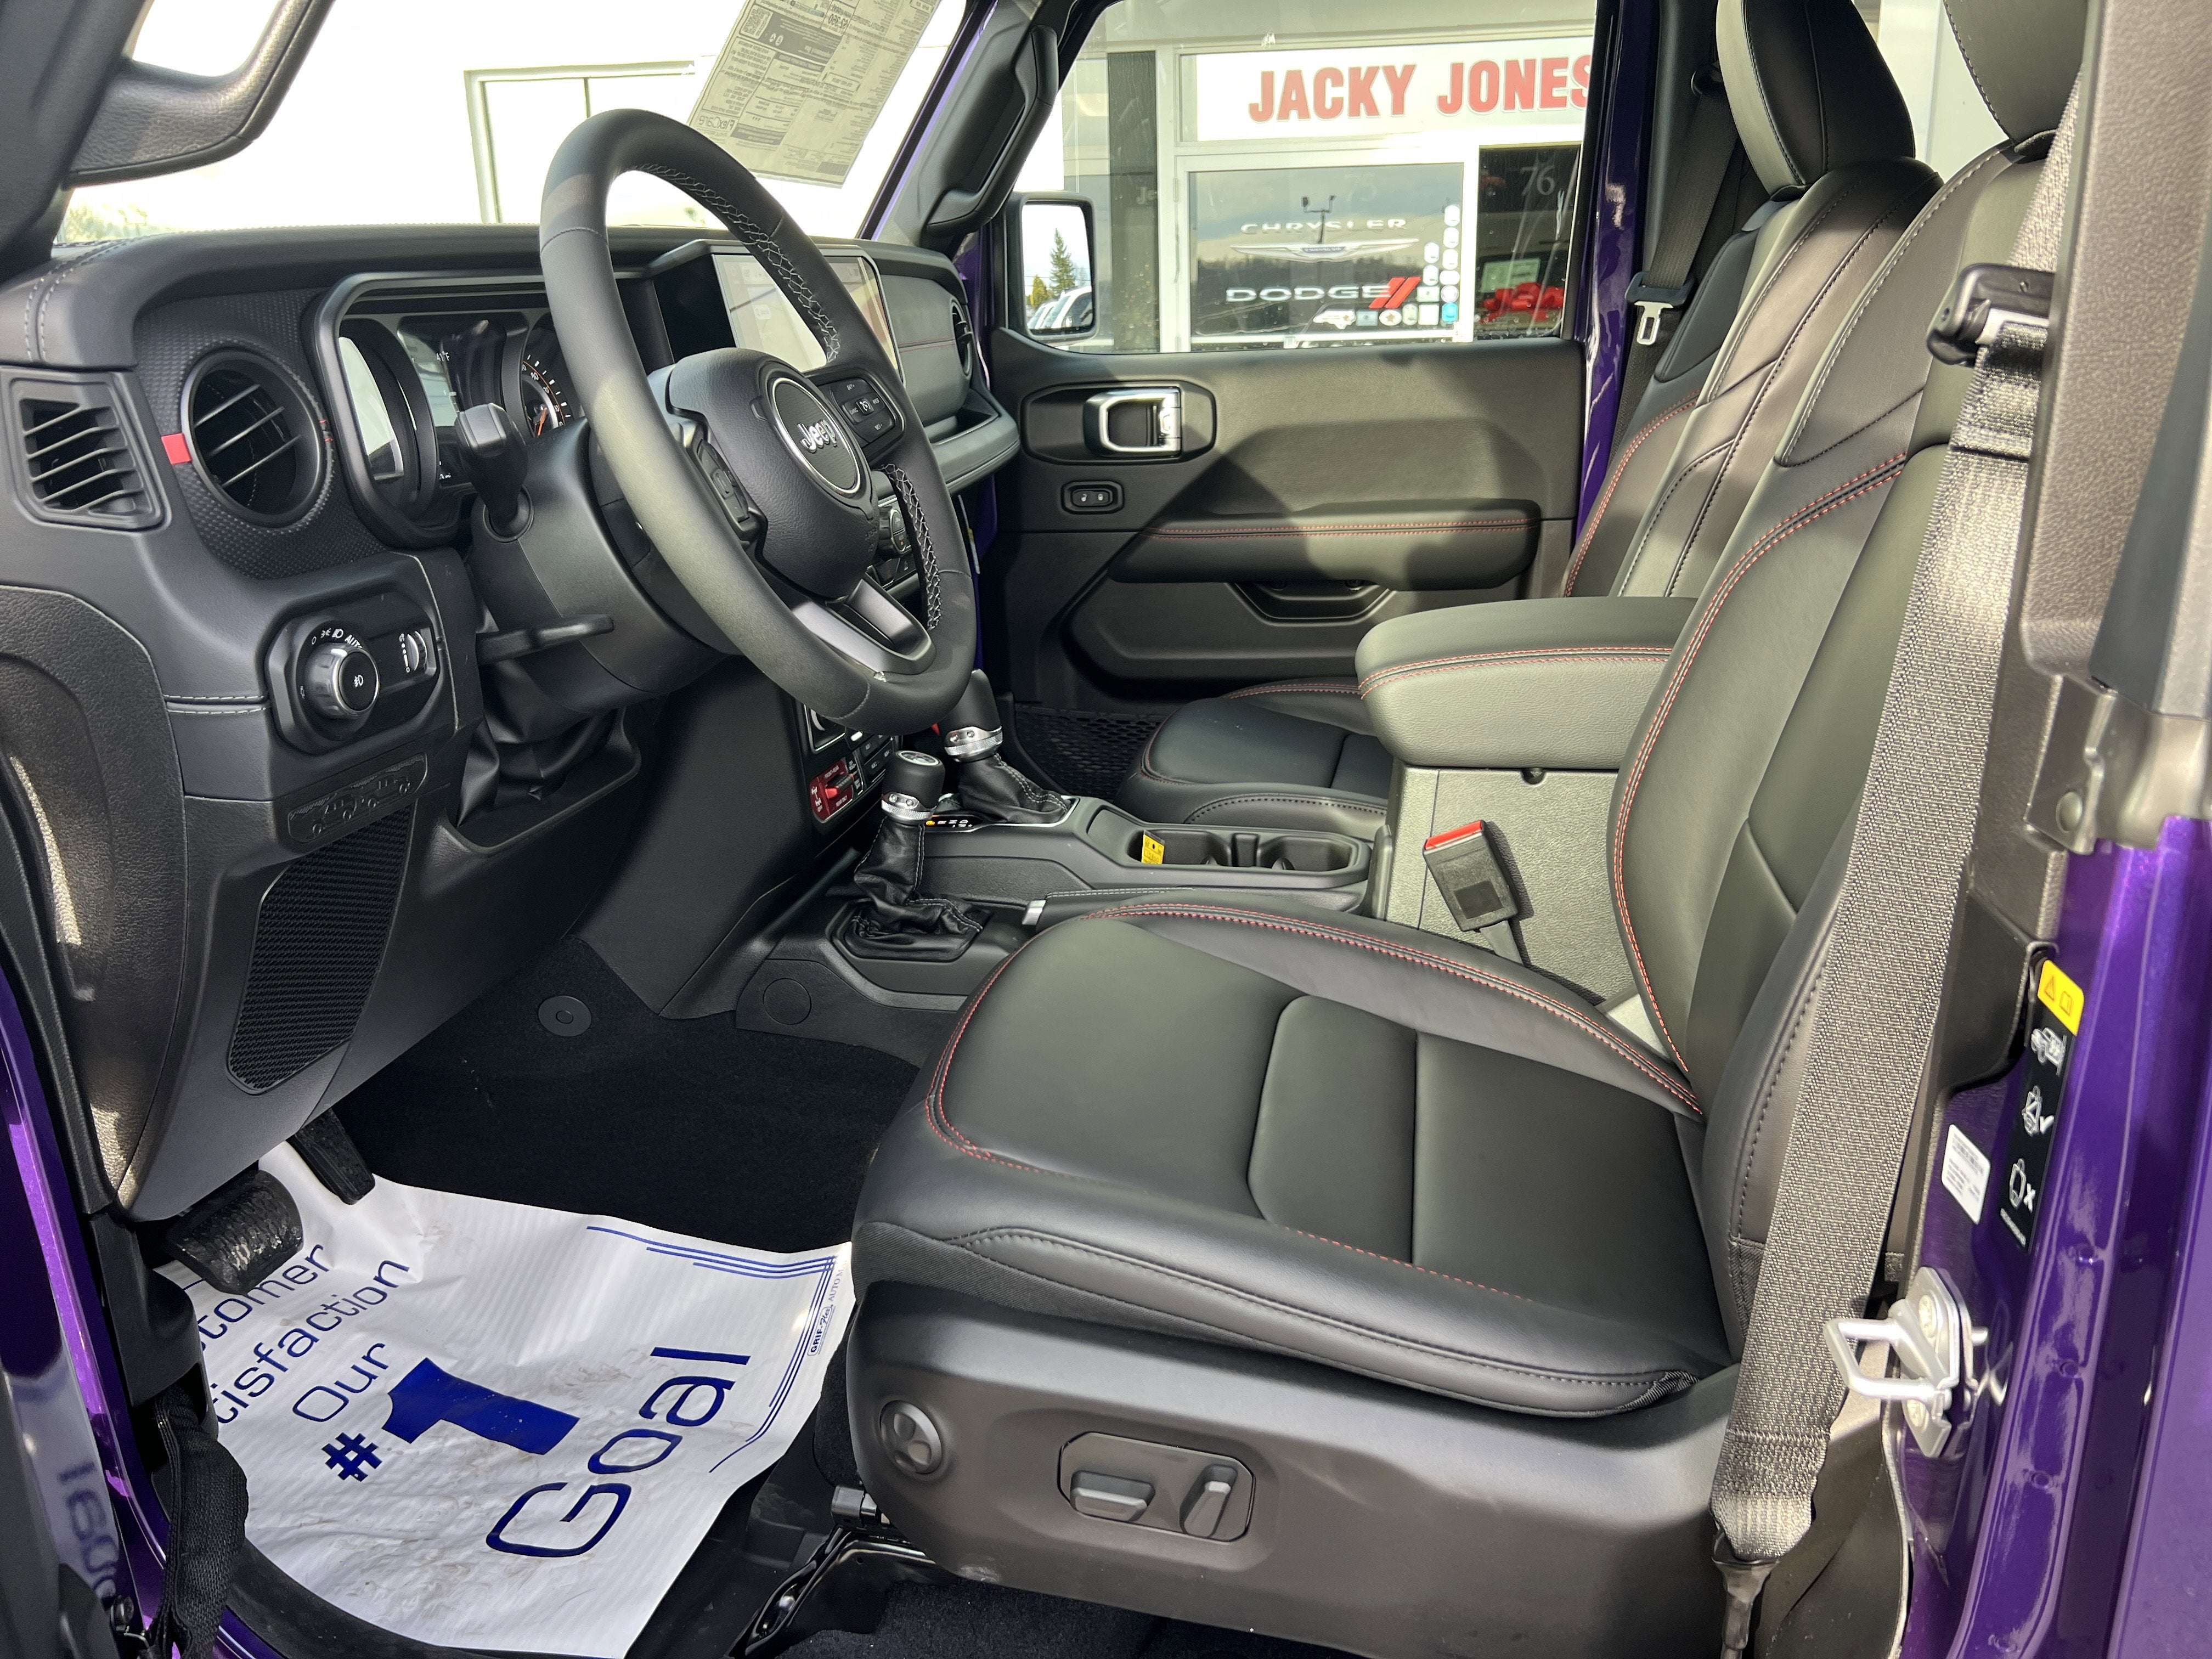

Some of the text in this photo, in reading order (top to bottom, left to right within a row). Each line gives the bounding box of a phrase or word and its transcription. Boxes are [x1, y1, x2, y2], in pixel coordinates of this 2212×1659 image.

[1248, 54, 1591, 124] JACKY JONES
[1520, 165, 1556, 196] 76
[1240, 218, 1407, 235] CHRYSLER
[1226, 285, 1391, 302] DODGE
[797, 419, 837, 453] Jeep
[345, 634, 363, 648] AUT
[196, 1244, 329, 1352] tomer
[292, 1342, 389, 1423] Our
[486, 1346, 752, 1558] Goal
